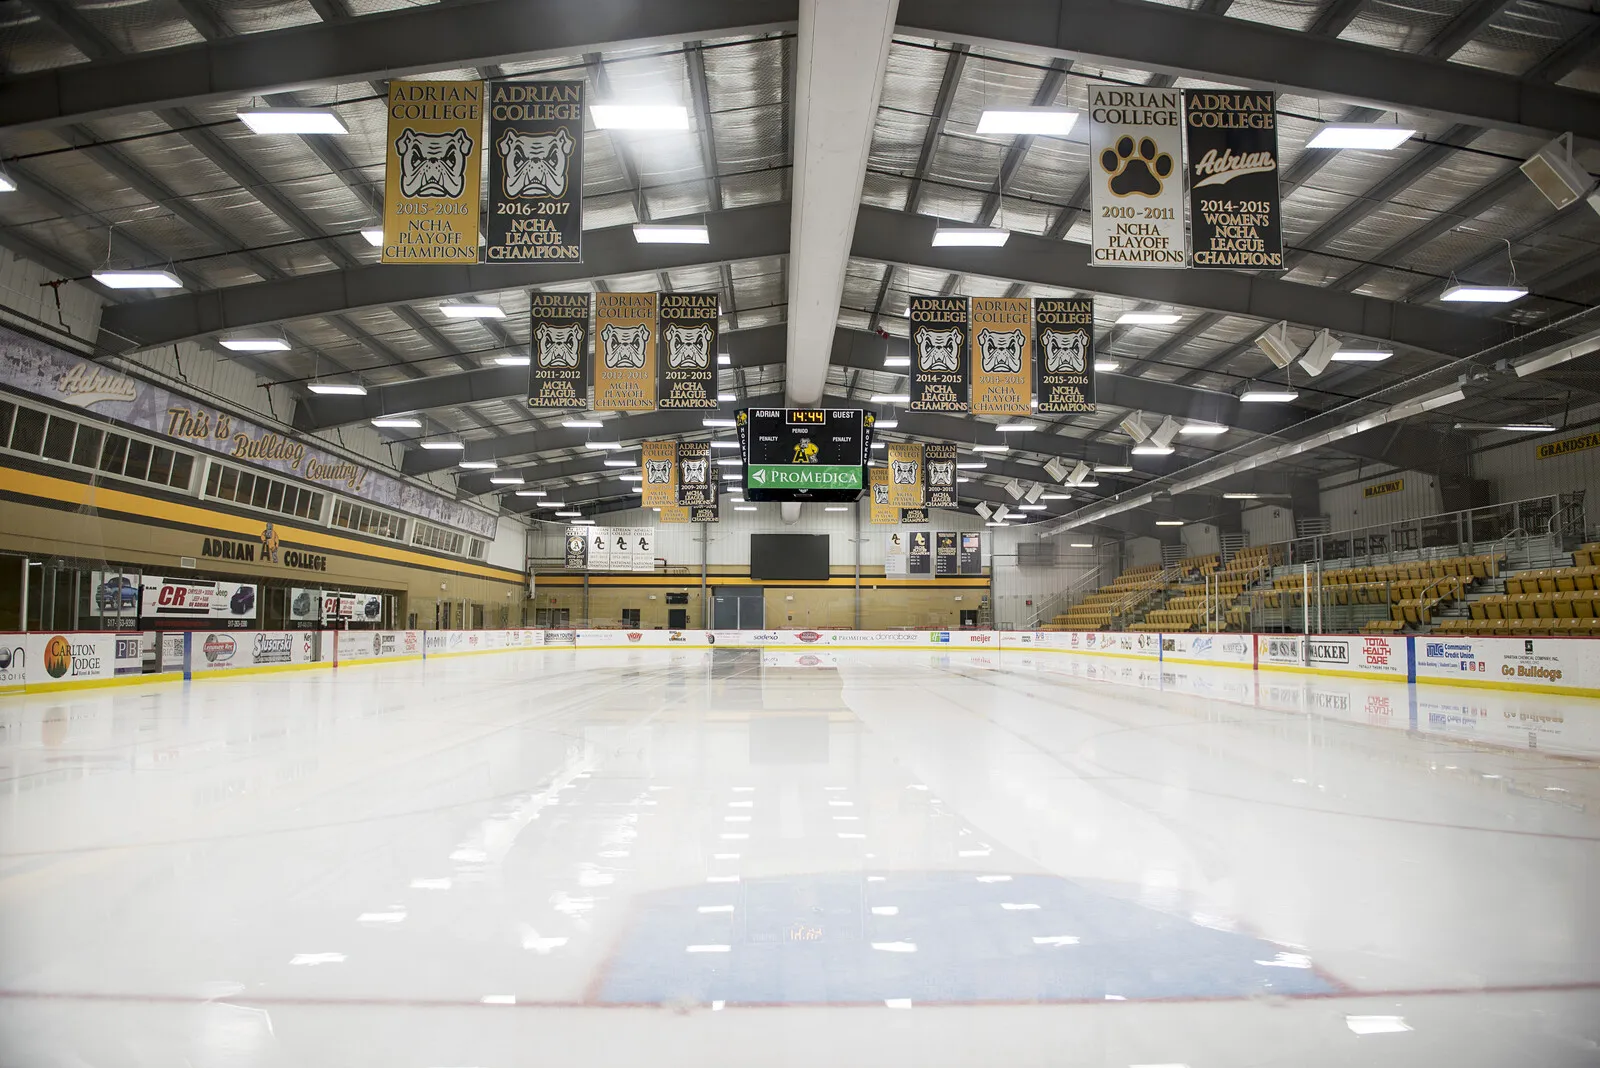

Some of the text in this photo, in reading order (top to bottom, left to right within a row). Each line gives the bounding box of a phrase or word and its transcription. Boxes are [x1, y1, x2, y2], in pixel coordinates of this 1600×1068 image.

[394, 86, 478, 101] ADRIAN
[495, 85, 581, 103] ADRIAN
[1094, 91, 1177, 108] ADRIAN
[1188, 94, 1272, 112] ADRIAN
[391, 104, 479, 120] COLLEGE
[492, 104, 580, 121] COLLEGE
[1092, 108, 1178, 127] COLLEGE
[1188, 112, 1274, 130] COLLEGE
[1194, 148, 1276, 177] Adrian
[396, 203, 469, 215] 2015-2016
[497, 202, 570, 215] 2016-2017
[1200, 200, 1270, 214] 2014-2015
[408, 219, 453, 231] NCHA
[510, 218, 557, 232] NCHA
[1203, 213, 1269, 227] WOMEN'S
[1116, 223, 1161, 236] NCHA
[1215, 226, 1259, 239] NCHA
[399, 232, 463, 245] PLAYOFF
[505, 232, 562, 246] LEAGUE
[1108, 236, 1170, 249] PLAYOFF
[1210, 238, 1265, 252] LEAGUE
[385, 246, 475, 259] CHAMPIONS
[487, 245, 579, 259] CHAMPIONS
[1094, 248, 1184, 263] CHAMPIONS
[1193, 251, 1281, 266] CHAMPIONS
[533, 295, 588, 307] ADRIAN
[599, 296, 653, 307] ADRIAN
[661, 296, 717, 307] ADRIAN
[911, 299, 967, 311] ADRIAN
[975, 300, 1028, 312] ADRIAN
[1037, 301, 1091, 313] ADRIAN
[532, 307, 588, 318] COLLEGE
[597, 308, 653, 319] COLLEGE
[660, 307, 717, 319] COLLEGE
[911, 311, 967, 323] COLLEGE
[974, 312, 1028, 324] COLLEGE
[1036, 313, 1092, 324] COLLEGE
[58, 362, 136, 397] Adrian
[535, 371, 581, 379] 2011-2012
[665, 371, 712, 380] 2012-2013
[915, 374, 962, 383] 2014-2015
[1043, 376, 1089, 384] 2015-2016
[542, 381, 573, 390] MCHA
[609, 382, 640, 391] MCHA
[672, 382, 704, 391] MCHA
[924, 385, 953, 394] NCHA
[987, 386, 1016, 395] NCHA
[1052, 386, 1081, 395] NCHA
[539, 390, 575, 398] LEAGUE
[604, 391, 645, 399] PLAYOFF
[669, 390, 707, 399] LEAGUE
[921, 393, 957, 402] LEAGUE
[982, 394, 1022, 403] PLAYOFF
[1049, 394, 1084, 403] LEAGUE
[528, 398, 587, 407] CHAMPIONS
[595, 399, 653, 408] CHAMPIONS
[659, 399, 717, 408] CHAMPIONS
[910, 401, 968, 411] CHAMPIONS
[973, 403, 1030, 412] CHAMPIONS
[1038, 402, 1095, 412] CHAMPIONS
[755, 410, 780, 418] ADRIAN
[792, 411, 824, 422] 14:44
[832, 411, 854, 419] GUEST
[168, 407, 370, 491] This is Bulldog Country!
[201, 537, 255, 562] ADRIAN
[283, 550, 327, 571] COLLEGE
[158, 585, 188, 606] CR
[216, 588, 228, 598] Jeep
[753, 632, 779, 640] sodexo
[970, 633, 991, 644] meijer
[1364, 637, 1389, 647] TOTAL
[51, 641, 96, 657] CARLTON
[252, 632, 293, 658] Slusarski
[1362, 646, 1392, 656] HEALTH
[1444, 643, 1472, 652] Community
[1366, 655, 1388, 665] CARE
[1444, 651, 1460, 659] Credit
[71, 656, 101, 676] LODGE
[1501, 664, 1563, 683] Go Bulldogs
